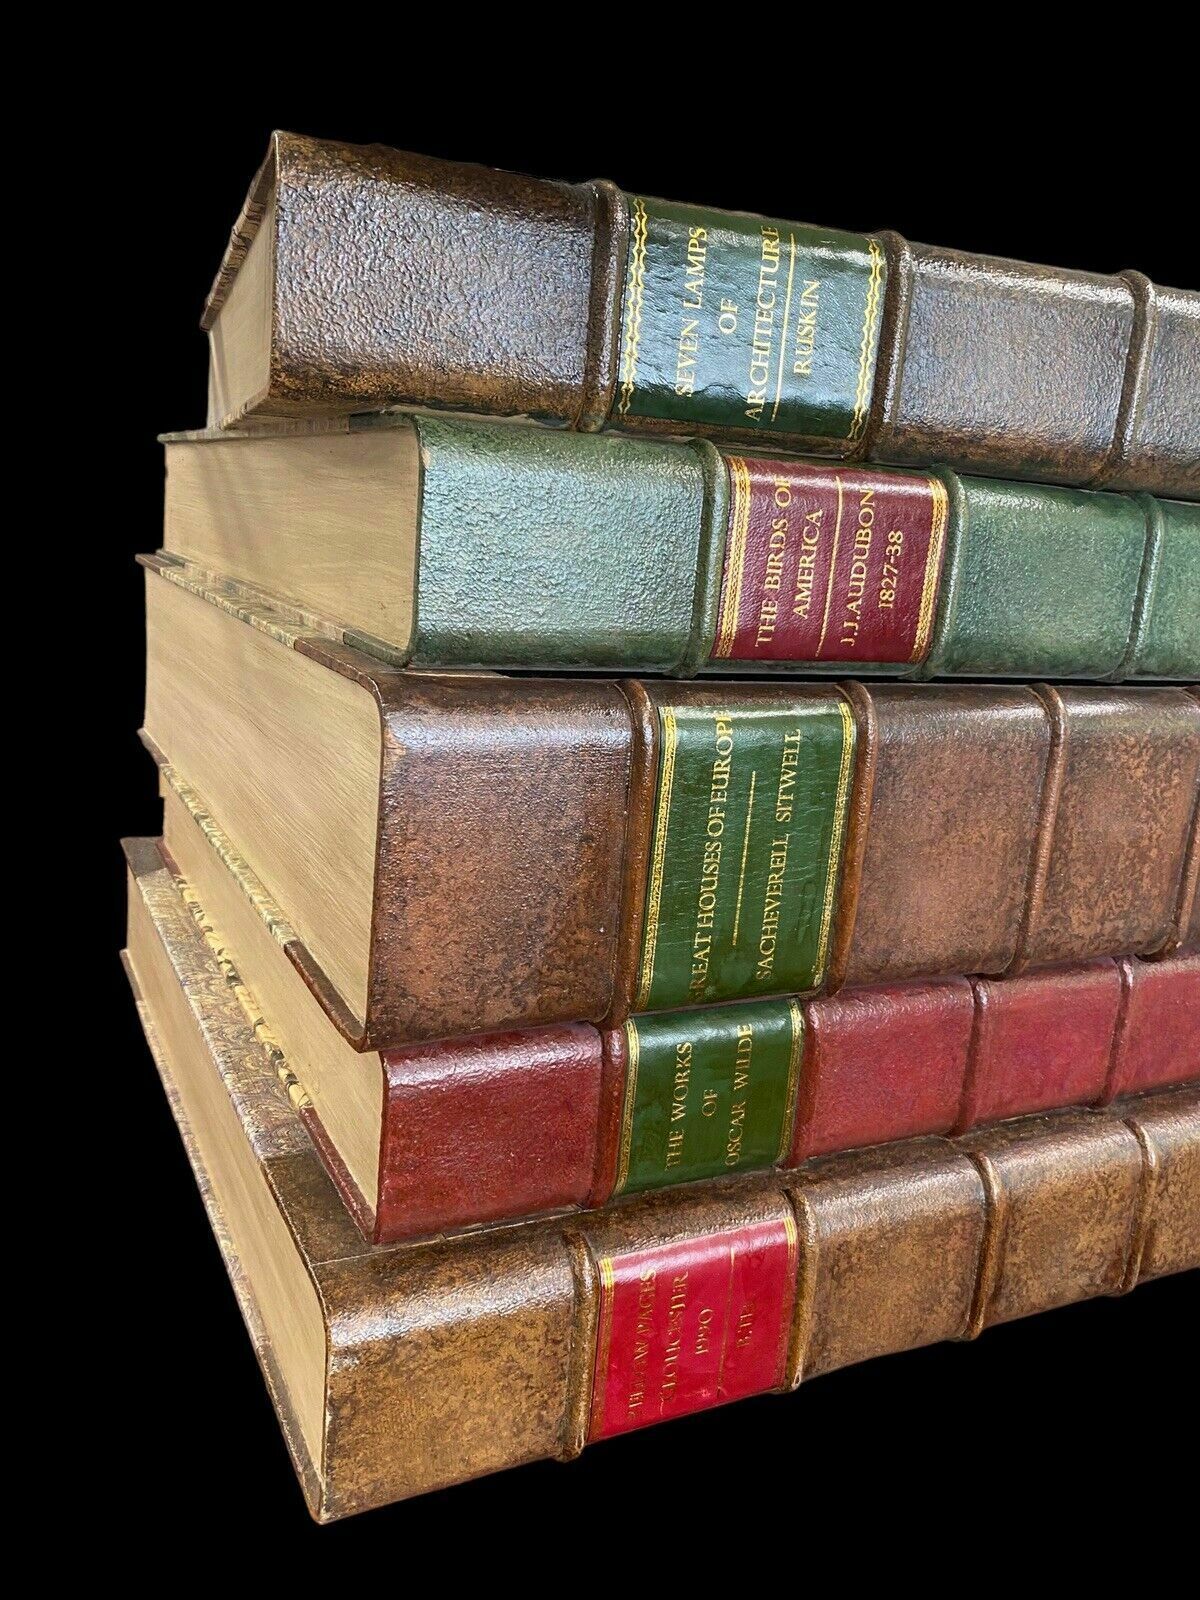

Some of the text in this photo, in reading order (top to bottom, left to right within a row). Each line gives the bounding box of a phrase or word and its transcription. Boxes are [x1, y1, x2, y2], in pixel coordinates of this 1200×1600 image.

[675, 226, 707, 397] SEVEN LAMPS
[718, 297, 738, 334] OF
[744, 225, 780, 422] ARCHITECTURE
[793, 279, 821, 375] RUSKIN
[755, 475, 792, 647] THE BIRDS OF
[793, 508, 823, 619] AMERICA
[840, 487, 876, 647] J.J.AUDUBON
[878, 530, 904, 609] 1827-38
[688, 709, 733, 1000] REAT HOUSES OF EUROPE
[756, 728, 802, 981] SACHEVERELL SITWELL
[664, 1042, 693, 1172] THE WORKS
[702, 1089, 719, 1117] OF
[724, 1023, 753, 1167] OSCAR WILDE
[695, 1307, 714, 1354] 1990
